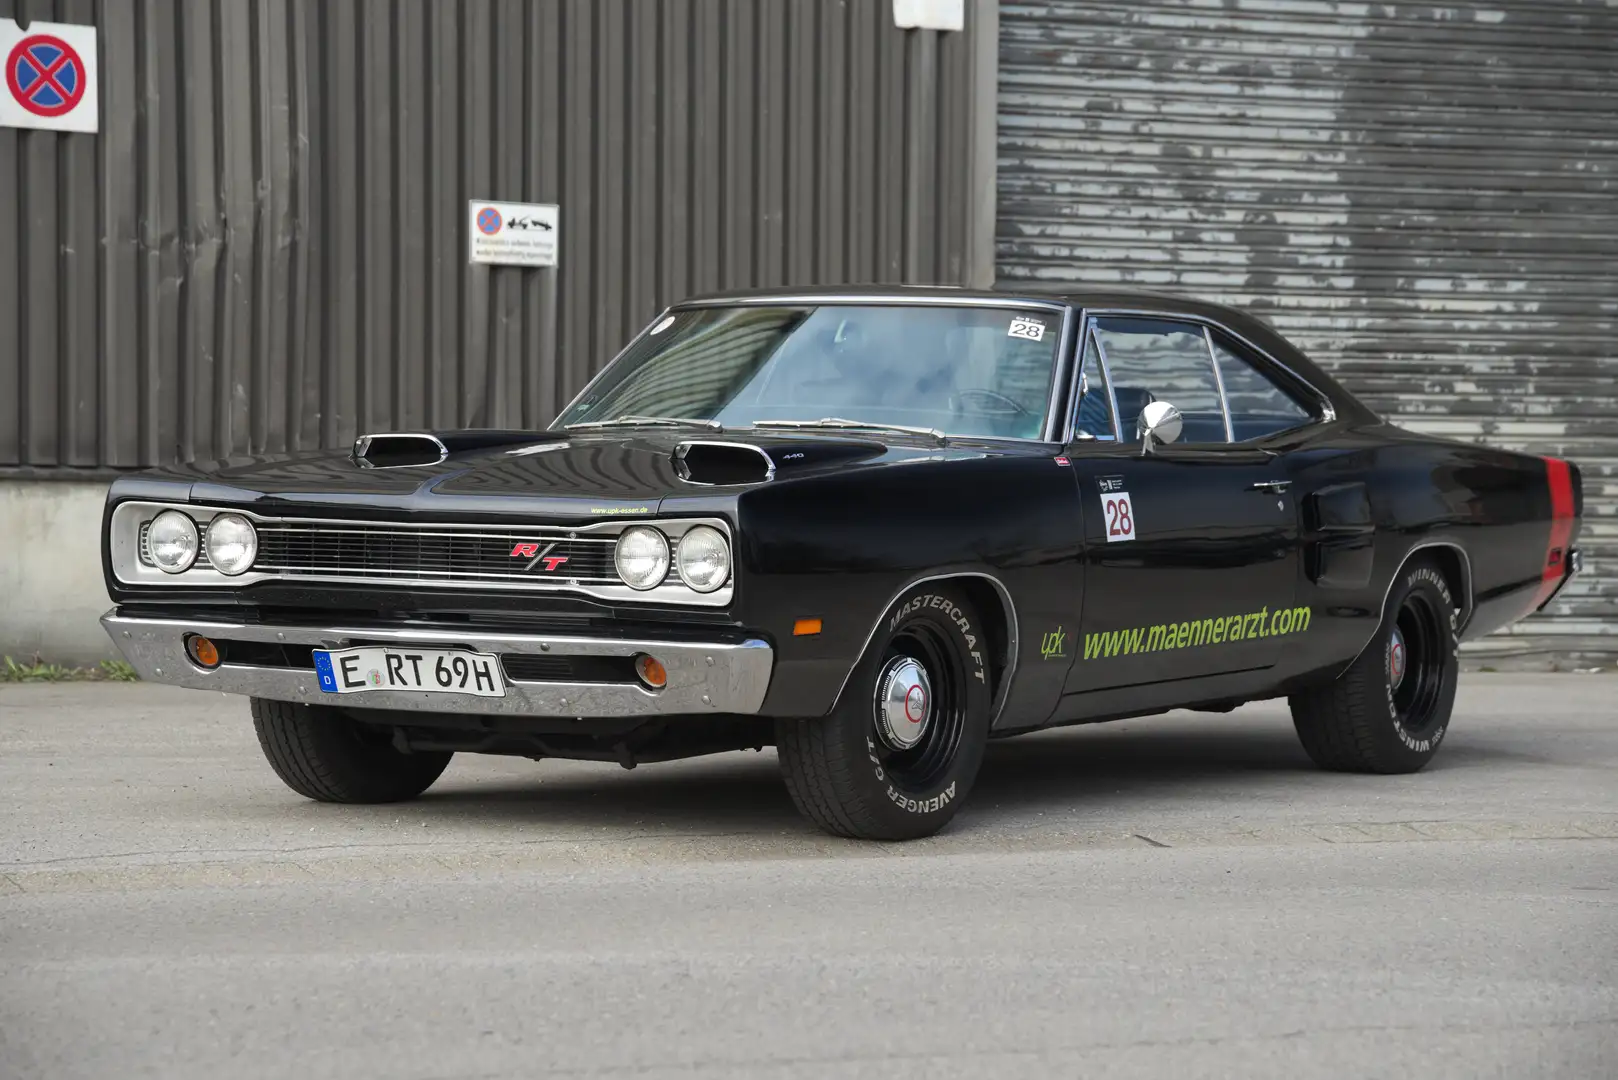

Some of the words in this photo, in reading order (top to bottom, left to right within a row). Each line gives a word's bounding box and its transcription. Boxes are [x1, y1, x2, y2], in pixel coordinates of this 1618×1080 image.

[1012, 323, 1040, 337] 28
[783, 452, 805, 460] 440
[1107, 498, 1132, 536] 28
[509, 542, 569, 571] R/T
[889, 594, 985, 685] MASTERCRAFT
[1083, 605, 1311, 660] www.maennerarzt.com
[324, 675, 332, 685] D
[339, 655, 366, 688] E
[385, 654, 423, 686] RT
[435, 656, 496, 692] 69H
[886, 780, 956, 814] AVENGER
